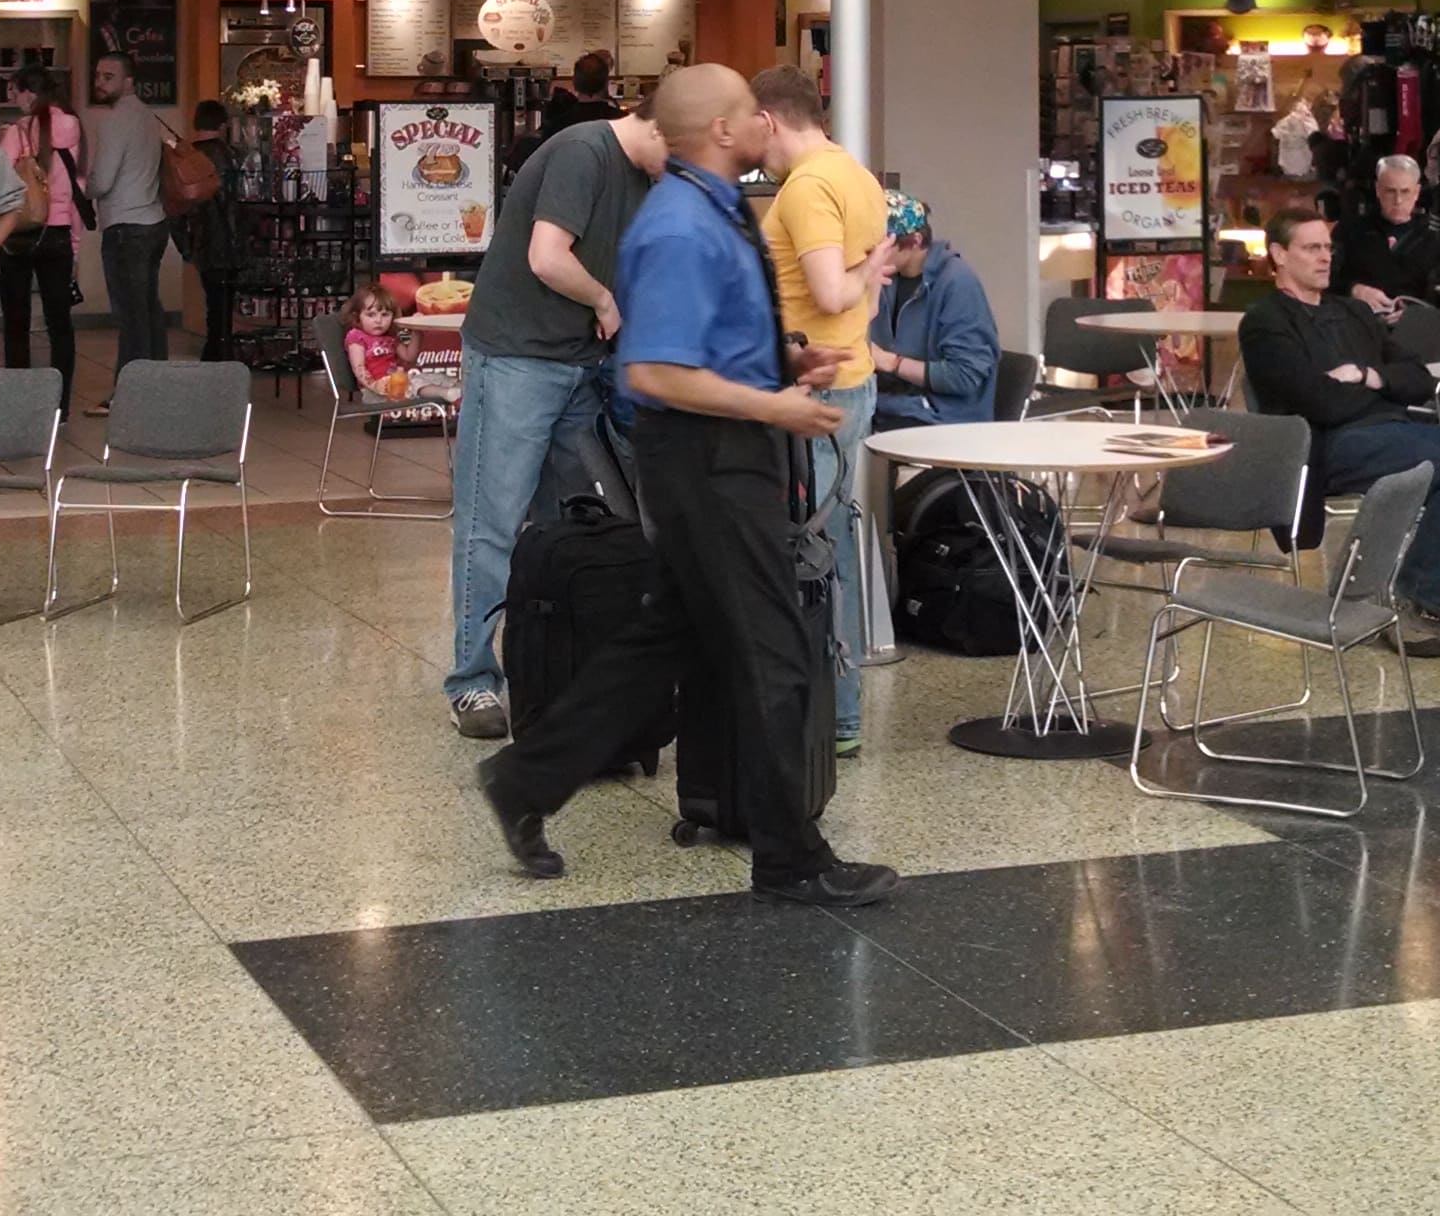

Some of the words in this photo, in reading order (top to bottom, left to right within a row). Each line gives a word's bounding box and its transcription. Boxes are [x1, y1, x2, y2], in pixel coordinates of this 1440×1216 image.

[1106, 108, 1144, 139] FRESH
[1146, 107, 1197, 139] BREWED
[391, 120, 484, 150] SPECIAL
[1128, 166, 1154, 178] Loose
[1109, 181, 1152, 196] ICED
[1154, 181, 1196, 195] TEAS
[417, 191, 459, 202] Croissant
[1121, 206, 1186, 230] ORGANIC
[410, 234, 428, 244] Hot
